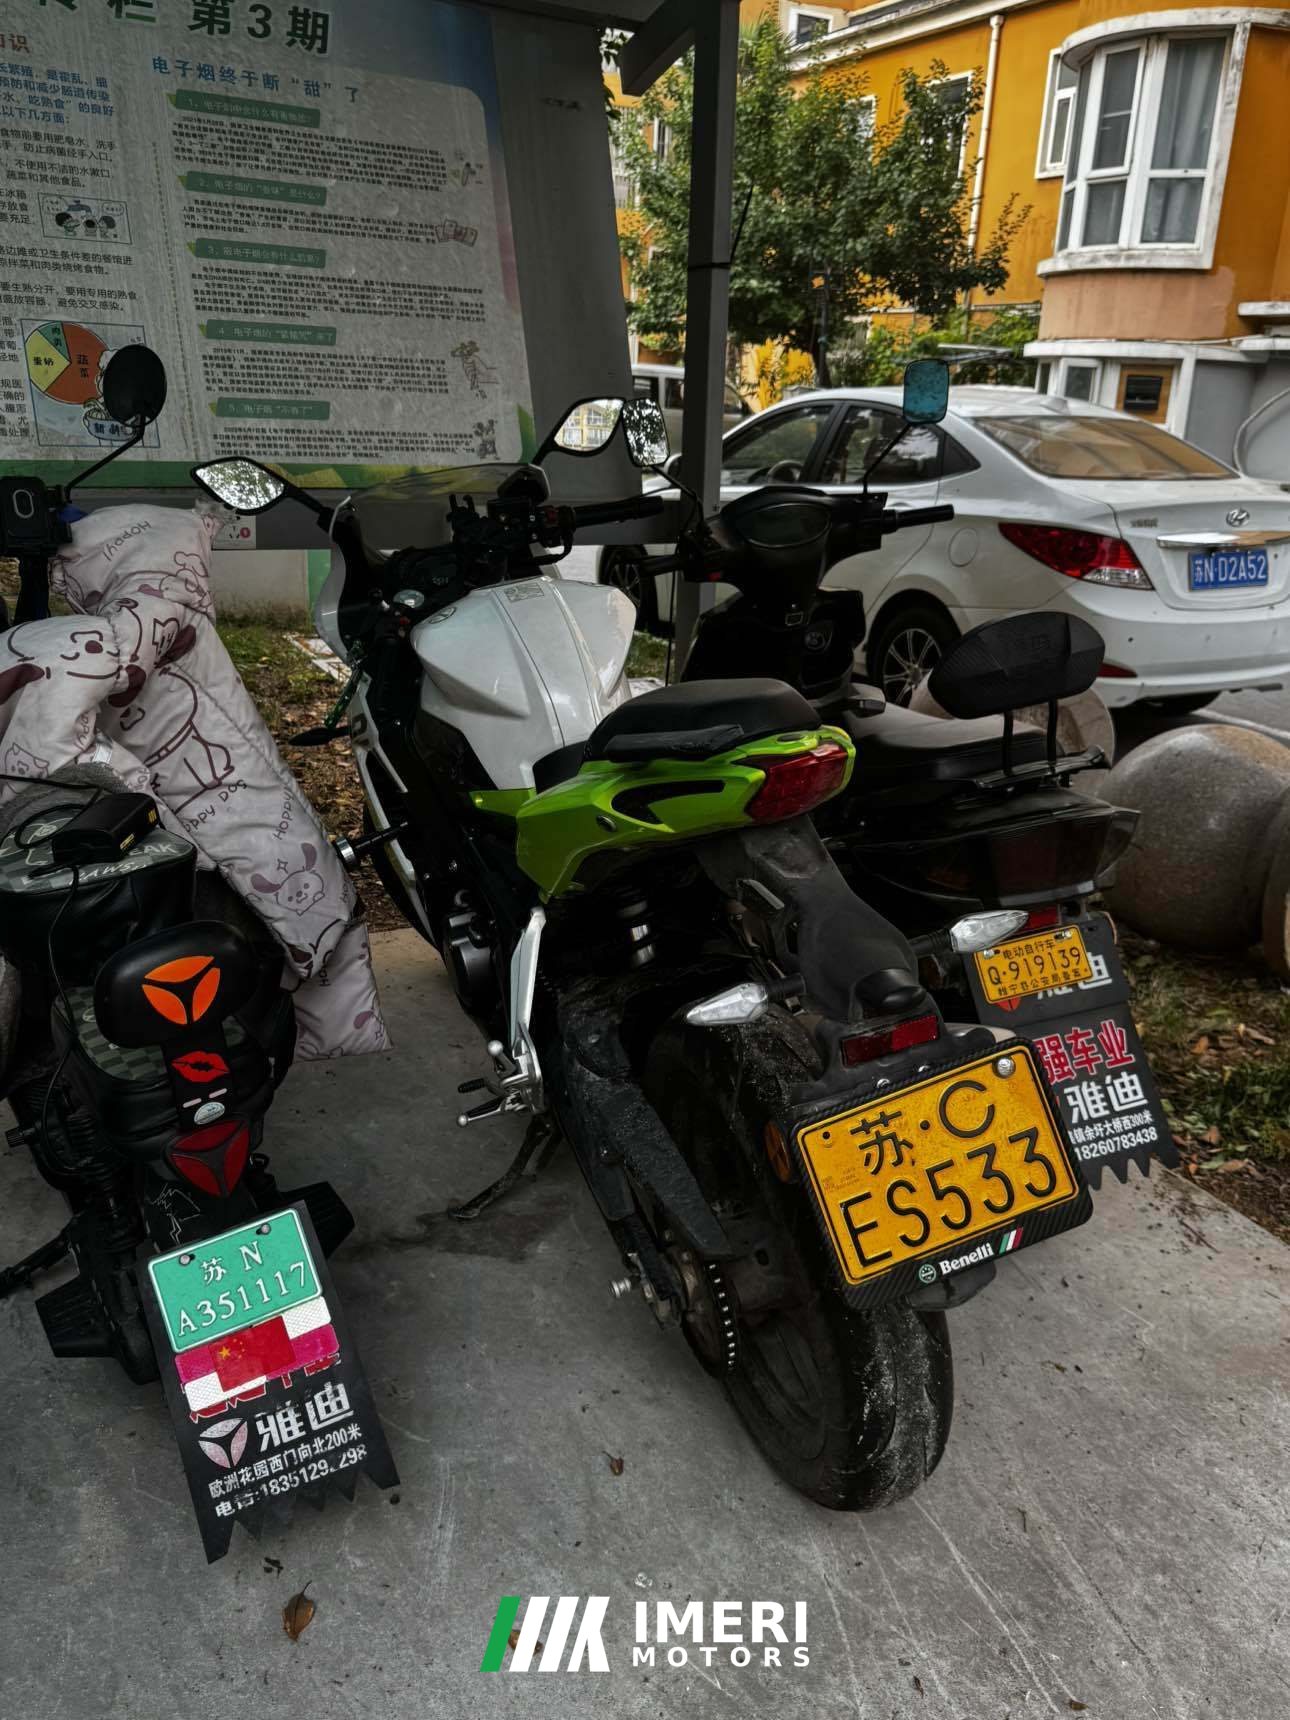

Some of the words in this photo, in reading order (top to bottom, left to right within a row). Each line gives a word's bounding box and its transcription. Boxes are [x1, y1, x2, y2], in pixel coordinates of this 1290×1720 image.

[1002, 939, 1057, 960] 电动自行车
[1063, 1071, 1149, 1124] 雅迪
[1072, 1126, 1159, 1162] 18260783438
[840, 1126, 1057, 1268] ES533
[939, 1242, 995, 1275] Benelli
[178, 1260, 306, 1338] A351117
[254, 1380, 355, 1453] 雅迪
[208, 1422, 363, 1499] 欧洲花园西门向北200米
